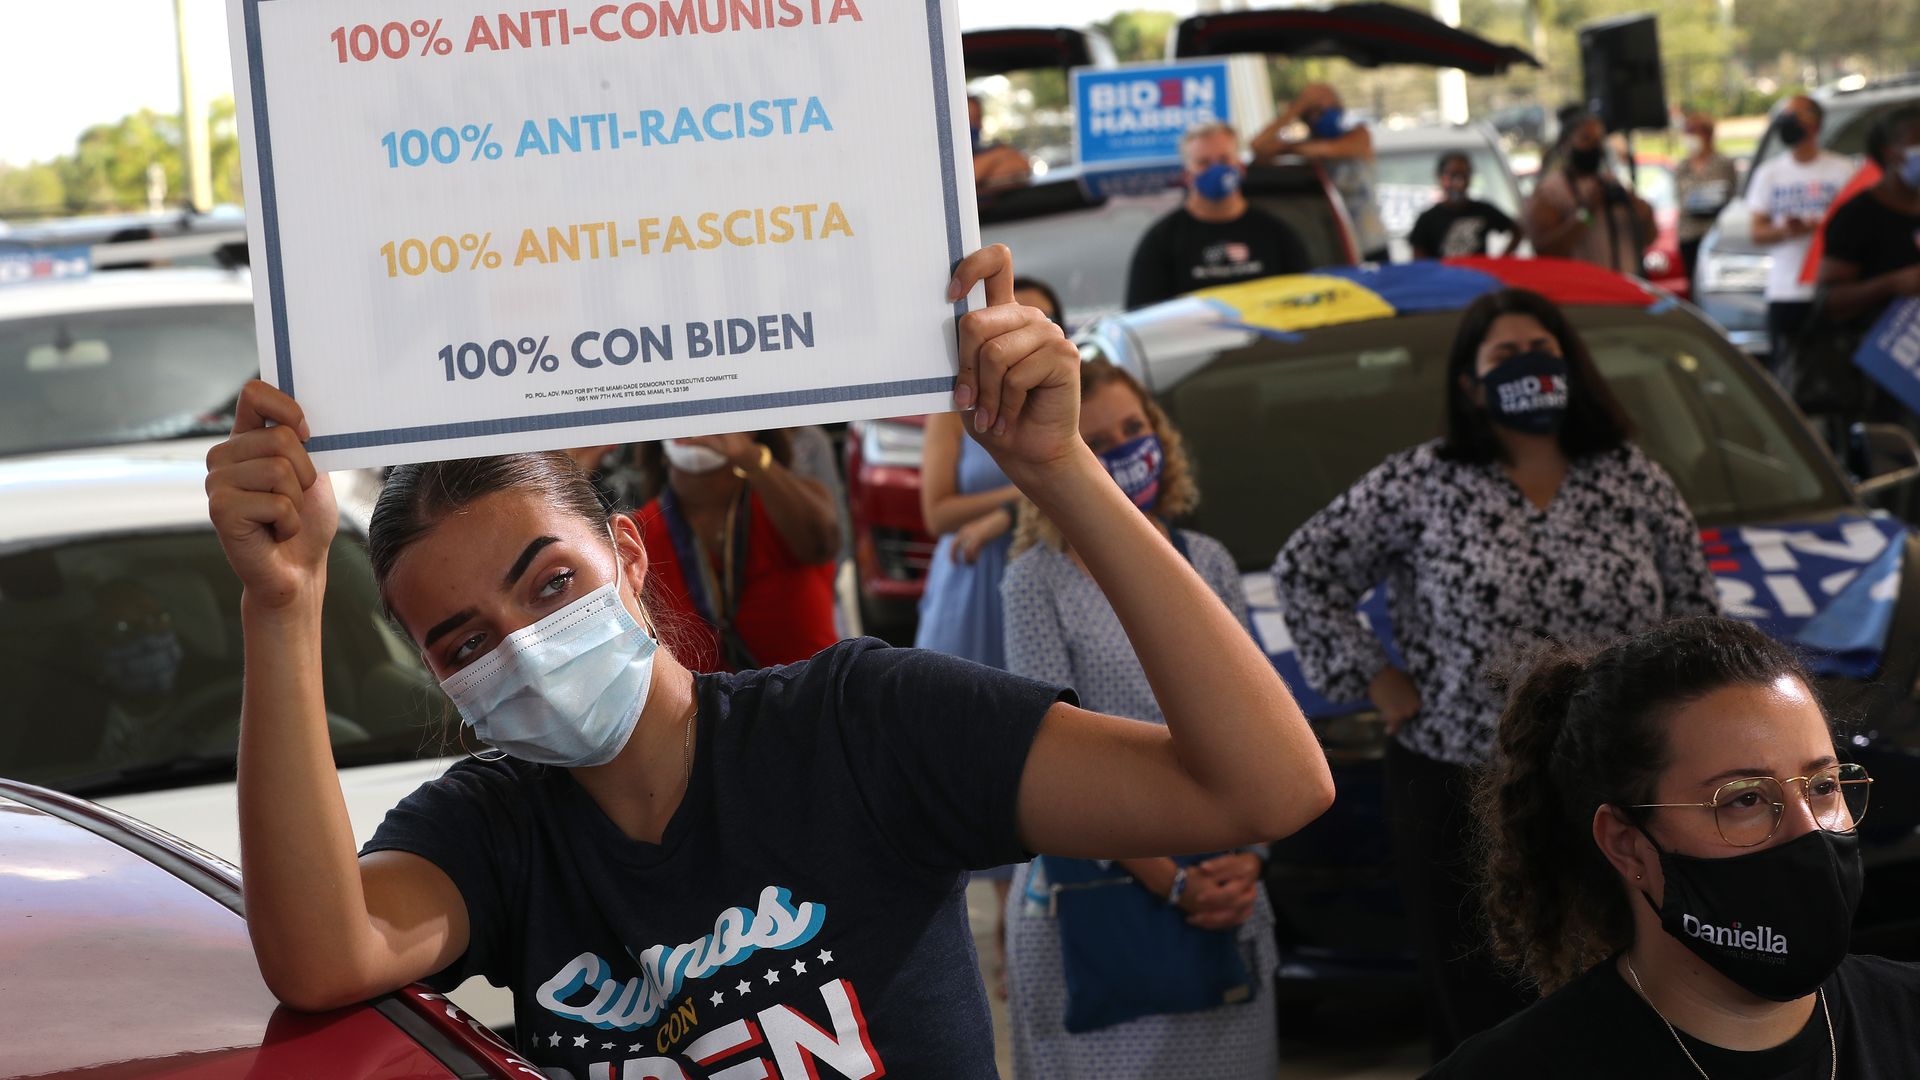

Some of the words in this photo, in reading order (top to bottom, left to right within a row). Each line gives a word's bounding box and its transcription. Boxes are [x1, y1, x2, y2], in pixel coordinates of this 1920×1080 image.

[330, 18, 453, 64] 100%
[464, 0, 863, 53] ANTI-COMUNISTA
[1090, 76, 1214, 111] BIDEN
[381, 123, 503, 169] 100%
[514, 96, 833, 158] ANTI-RACISTA
[379, 232, 501, 278] 100%
[513, 202, 854, 268] ANTI-FASCISTA
[437, 336, 560, 383] 100%
[570, 325, 674, 370] CON
[684, 312, 815, 358] BIDEN
[606, 383, 638, 391] MIAMI-DADE
[639, 380, 675, 388] DEMOCRATIC
[676, 377, 705, 385] EXECUTIVE
[706, 374, 738, 382] COMMITTEE
[1683, 914, 1787, 954] Daniella
[656, 996, 698, 1054] CON
